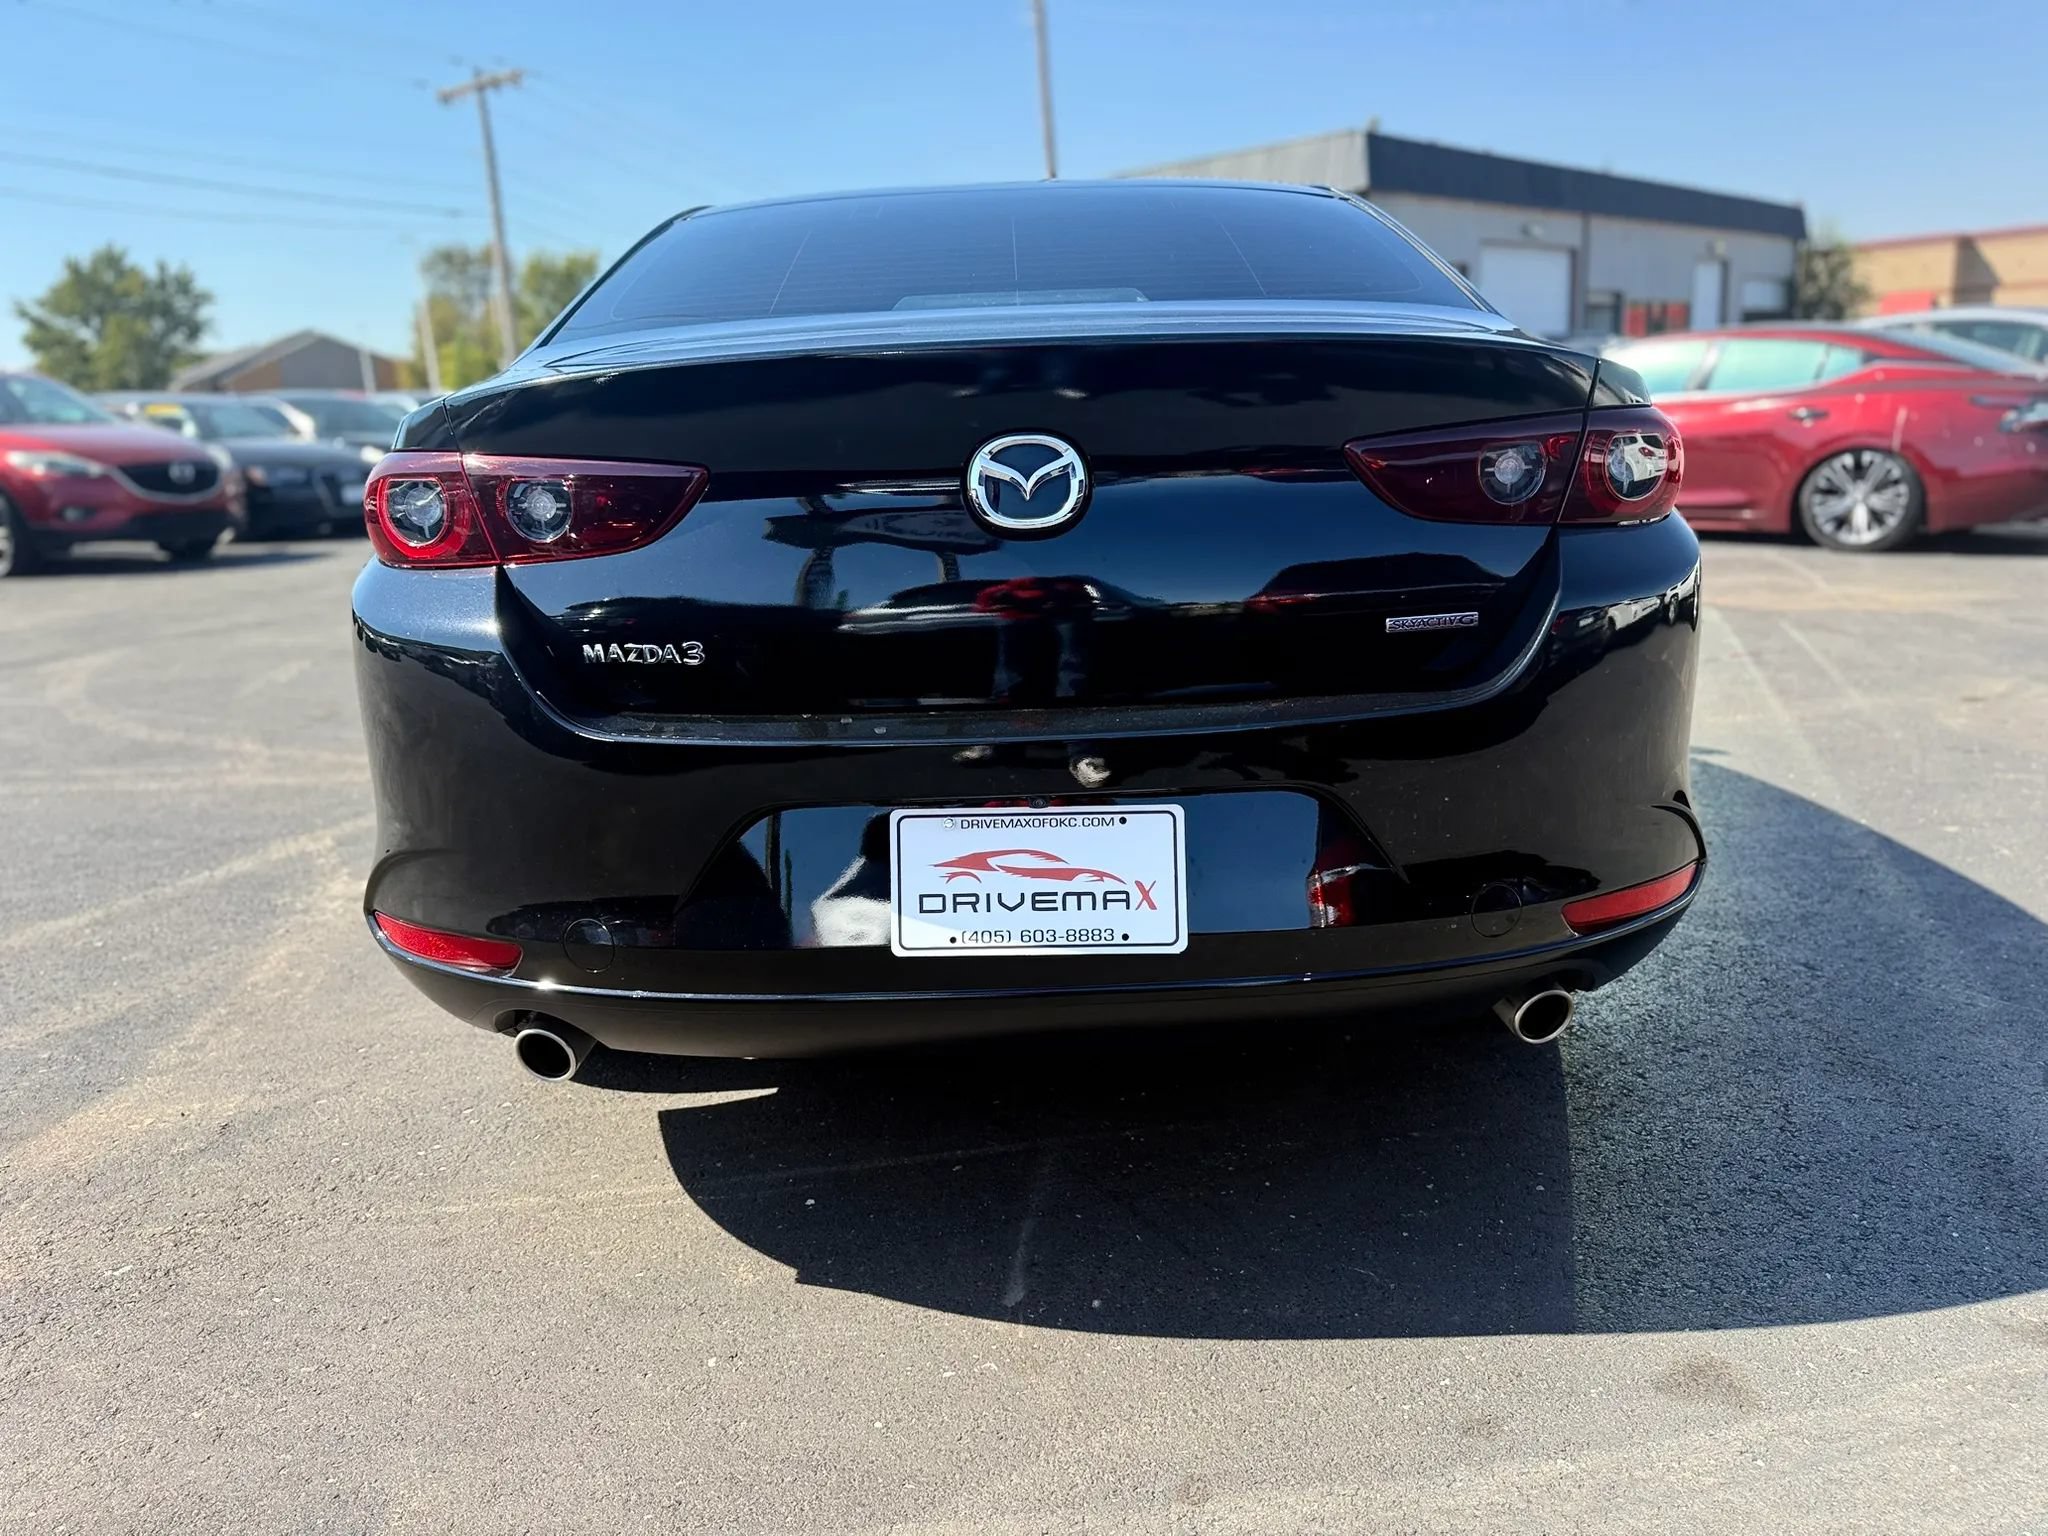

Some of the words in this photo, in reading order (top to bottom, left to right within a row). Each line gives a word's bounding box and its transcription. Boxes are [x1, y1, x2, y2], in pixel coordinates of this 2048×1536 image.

[582, 641, 705, 665] MAZDA3
[960, 817, 1115, 830] DRIVEMAXOFOKC.COM
[919, 880, 1158, 914] DRIVEMAX
[961, 930, 1012, 944] (405)
[1020, 928, 1115, 943] 603-8883
